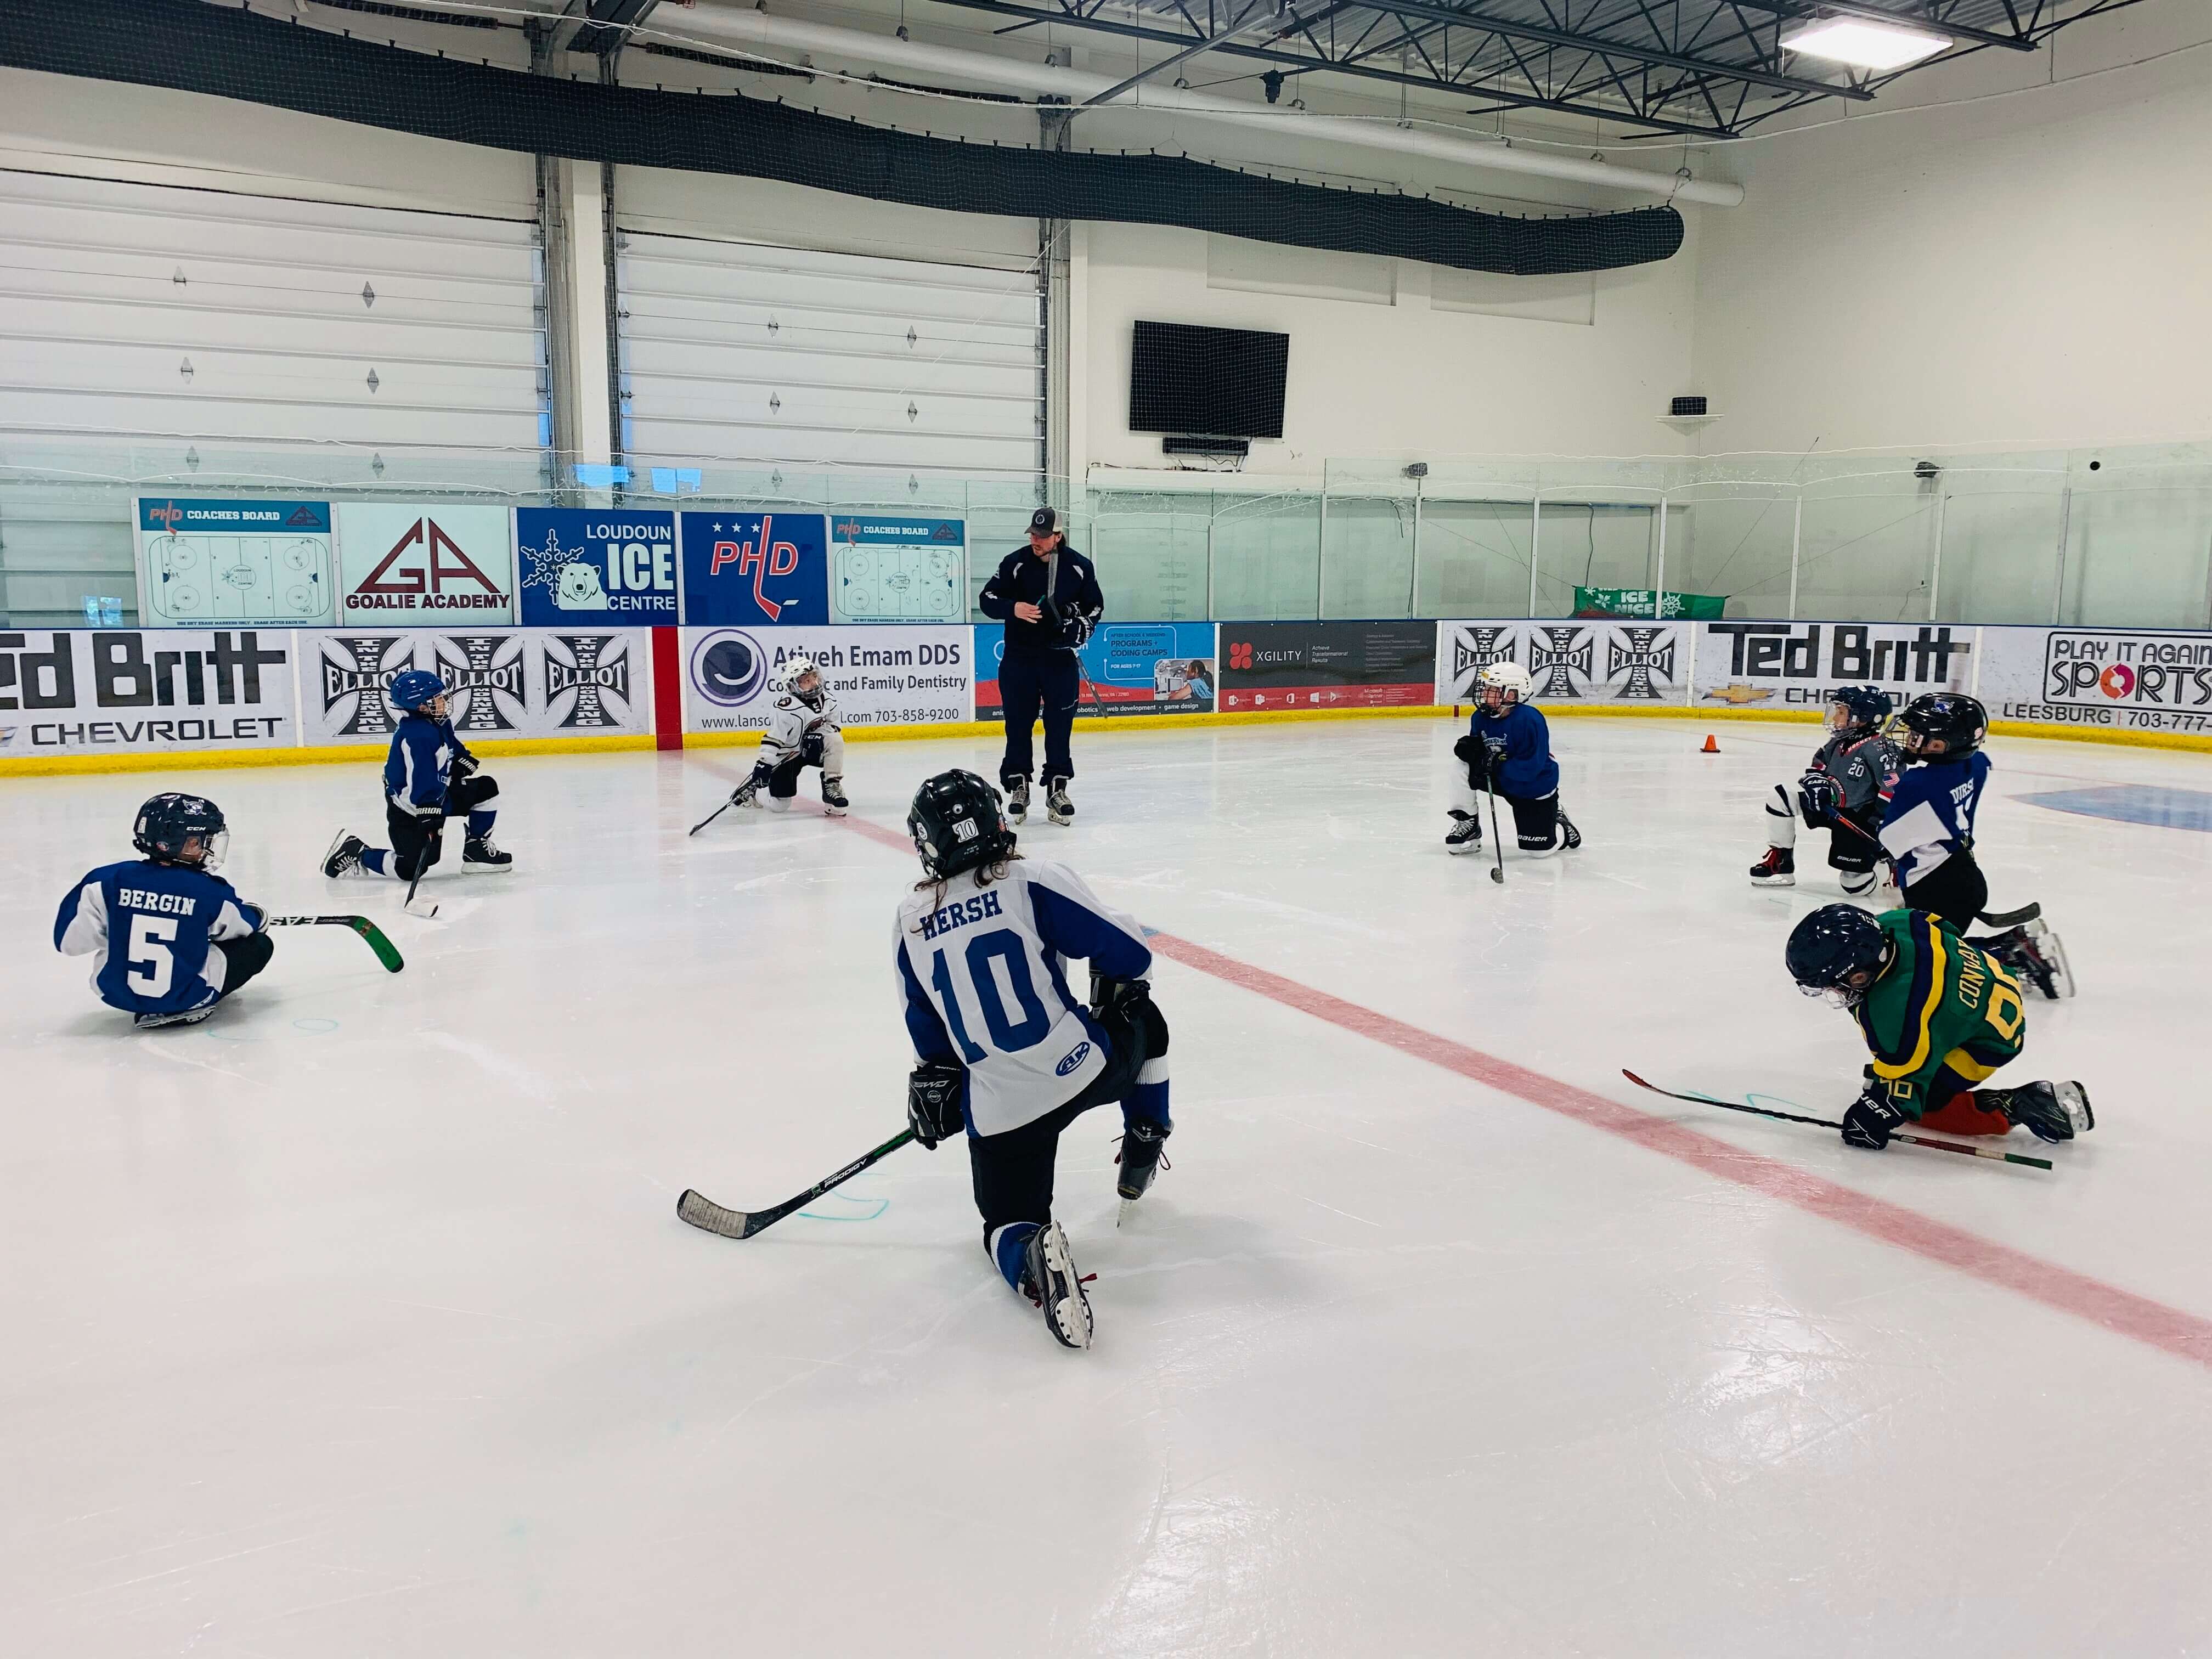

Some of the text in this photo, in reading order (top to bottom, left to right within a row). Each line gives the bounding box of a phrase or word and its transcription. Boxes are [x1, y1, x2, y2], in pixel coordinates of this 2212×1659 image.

[187, 510, 240, 520] COACHES
[242, 511, 280, 521] BOARD
[586, 524, 671, 540] LOUDOUN
[864, 526, 900, 534] COACHES
[607, 543, 674, 591] ICE
[346, 594, 510, 610] GOALIE ACADEMY
[607, 595, 675, 611] CENTRE
[1614, 603, 1655, 614] NICE
[1621, 591, 1649, 603] ICE
[1476, 628, 1494, 639] IN
[1478, 640, 1492, 652] THE
[850, 645, 912, 667] Emam
[919, 644, 961, 665] DDS
[1256, 650, 1302, 662] XGILITY
[1456, 645, 1513, 673] ELLIOT
[1531, 646, 1591, 672] ELLIOT
[1548, 628, 1572, 697] IN THE MORNING
[1609, 646, 1672, 673] ELLIOT
[1628, 629, 1652, 698] IN THE MORNING
[1708, 623, 1971, 683] Ted Britt
[2054, 639, 2212, 665] PLAY IT AGAIN
[92, 631, 286, 708] Britt
[438, 661, 521, 695] ELLIOT
[547, 659, 625, 695] ELLIOT
[573, 637, 603, 726] IN THE MORNING
[354, 639, 387, 733] IN THE MORNING
[466, 638, 497, 729] IN THE MORNING
[833, 676, 857, 691] and
[861, 675, 904, 693] Family
[908, 675, 967, 691] Dentistry
[2051, 661, 2212, 706] SPORTS
[875, 708, 959, 723] 703-858-9200
[1120, 704, 1156, 713] development
[2004, 703, 2112, 724] LEESBURG
[31, 718, 283, 745] CHEVROLET
[1847, 763, 1865, 777] 20
[1949, 777, 1974, 805] DURS
[956, 820, 977, 841] 10
[1517, 834, 1548, 842] BAUER
[119, 888, 197, 916] BERGIN
[919, 889, 1003, 941] HERSH
[127, 914, 179, 998] 5
[932, 928, 1051, 1065] 10
[824, 1158, 867, 1188] PRODIGY
